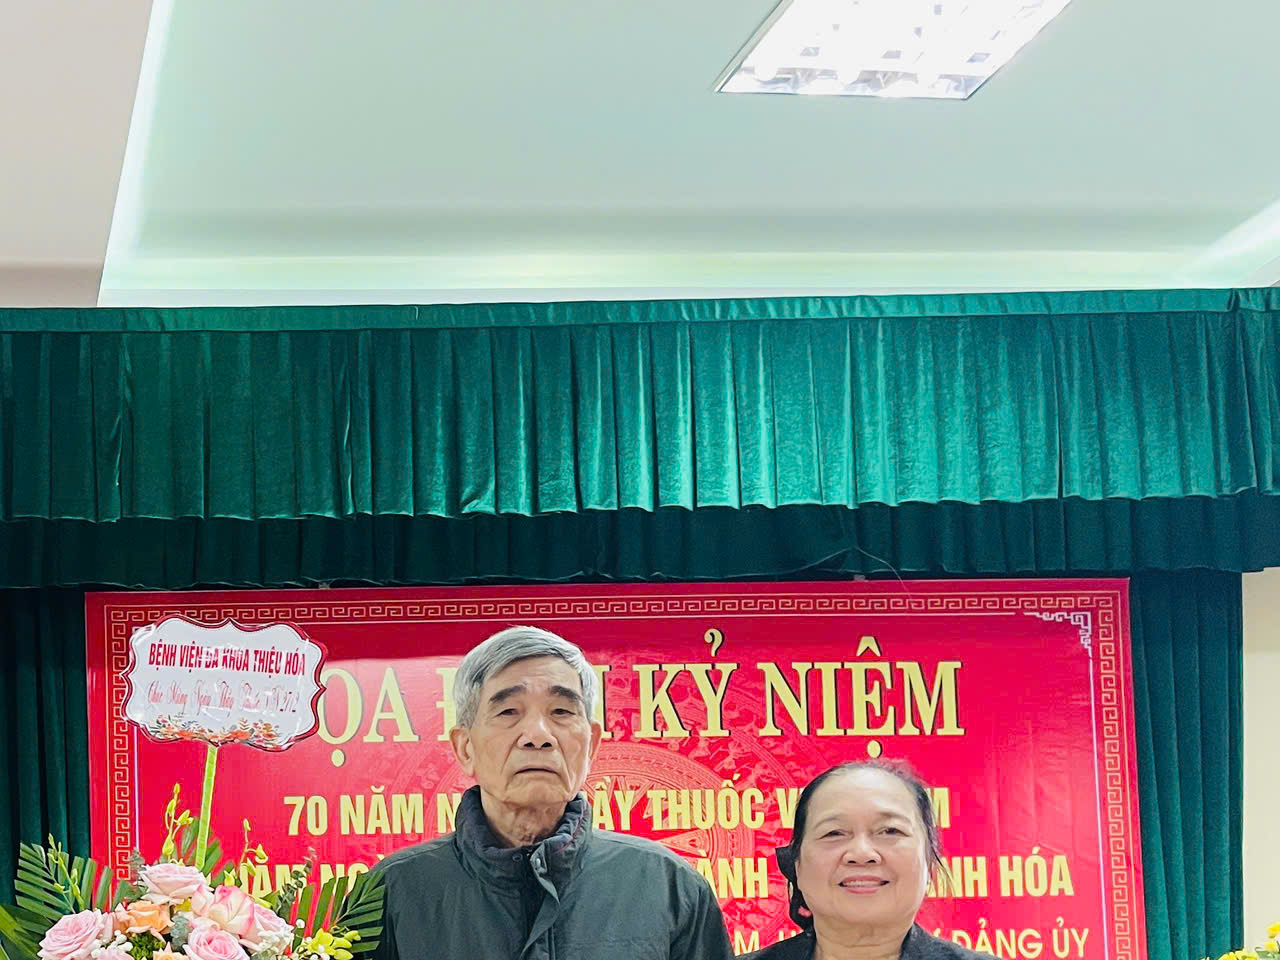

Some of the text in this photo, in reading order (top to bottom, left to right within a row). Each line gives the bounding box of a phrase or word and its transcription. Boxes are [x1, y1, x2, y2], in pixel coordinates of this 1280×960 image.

[148, 638, 177, 671] BỆNH
[179, 640, 203, 673] VIỆN
[253, 645, 282, 678] THIỆU
[284, 647, 306, 676] HÓA
[317, 667, 420, 768] ỌA
[632, 628, 739, 739] KỶ
[756, 635, 967, 759] NIỆM
[283, 794, 328, 836] 70
[340, 785, 424, 835] NĂM
[590, 775, 635, 831] ẦY
[647, 773, 765, 831] THUỐC
[999, 846, 1075, 897] HÓA
[1052, 916, 1089, 959] ỦY
